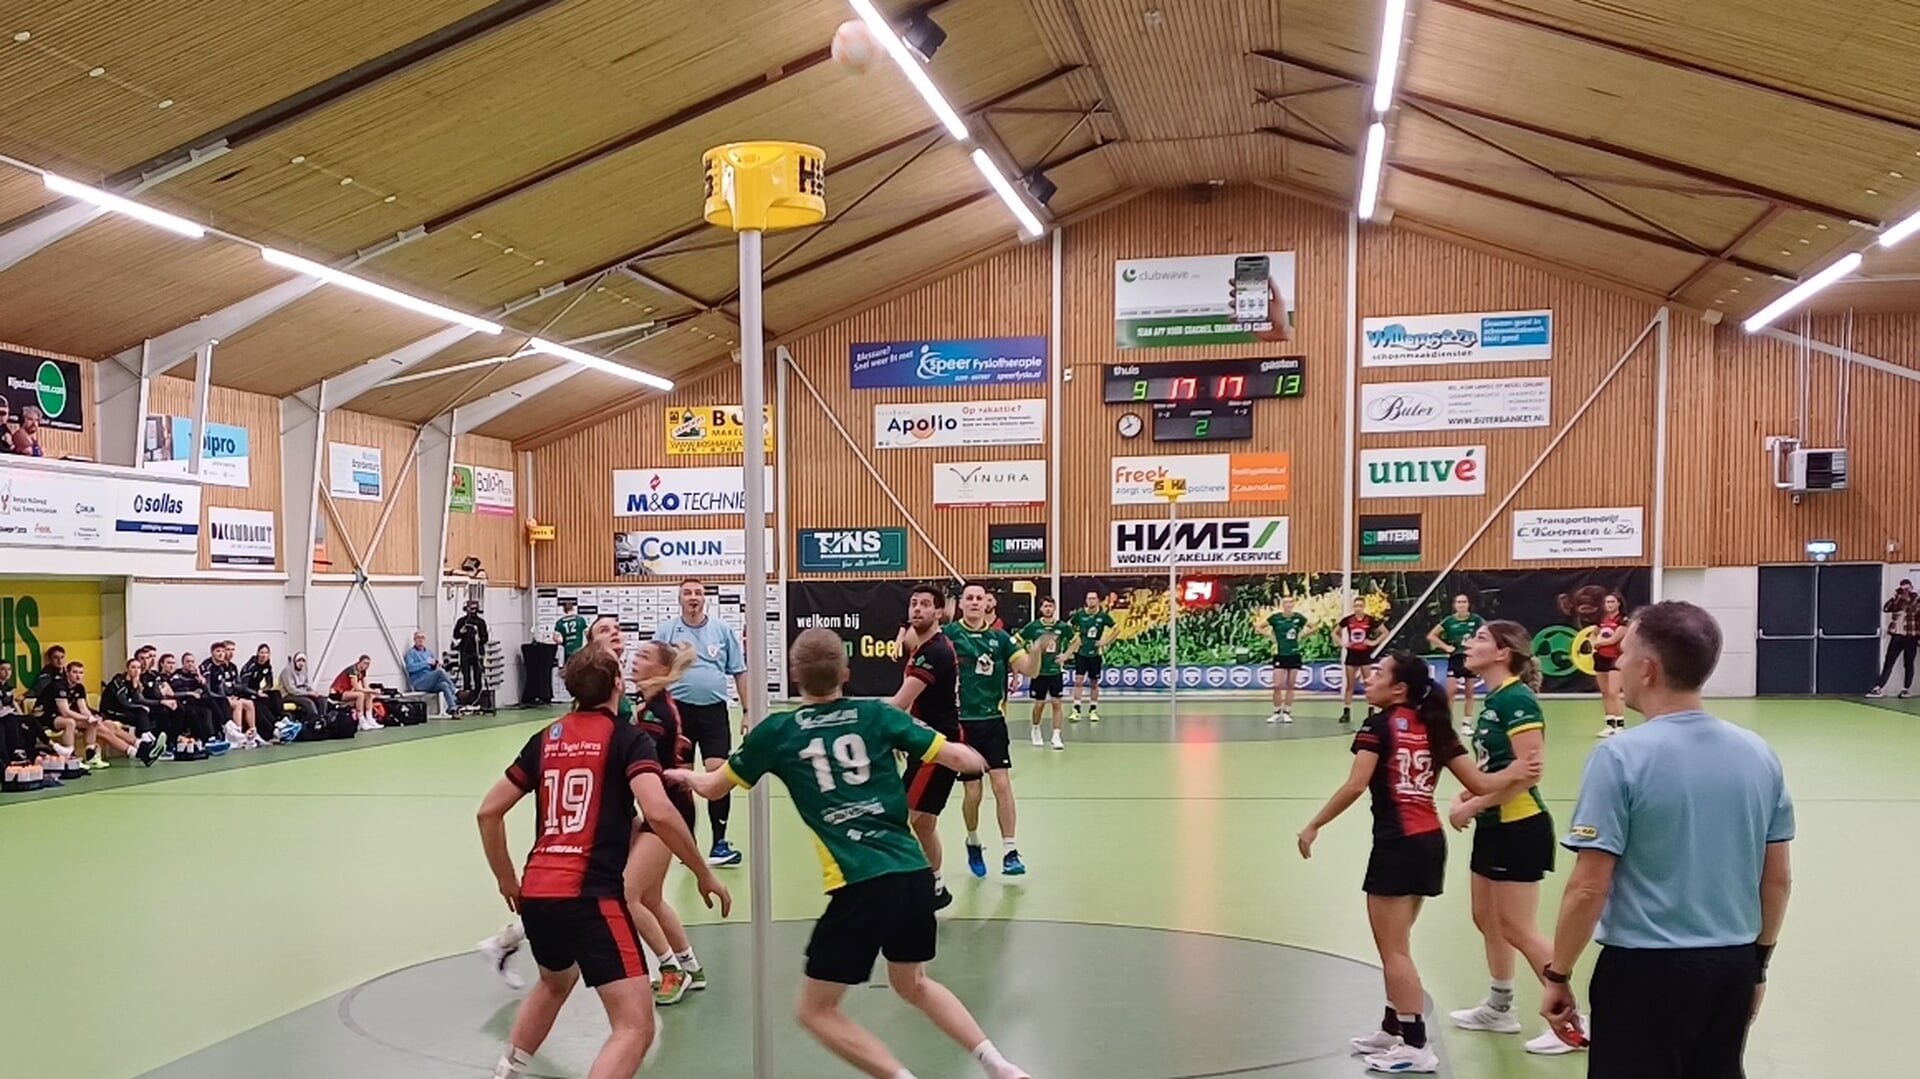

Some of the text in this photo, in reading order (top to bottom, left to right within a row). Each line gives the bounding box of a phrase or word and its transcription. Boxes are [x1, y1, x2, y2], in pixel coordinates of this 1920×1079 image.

[929, 357, 971, 374] speer
[1113, 360, 1299, 376] thuis gasten
[1132, 374, 1301, 400] 9 17 17 13
[962, 404, 1023, 416] Op vakantie?
[1375, 396, 1434, 422] Buter
[1195, 419, 1209, 436] 2
[949, 465, 1030, 483] VINURA
[1115, 465, 1170, 483] Freek
[1368, 449, 1478, 484] univé
[143, 493, 184, 514] sollas
[626, 491, 746, 513] M&O TECHNIE
[640, 536, 722, 561] CONIJN
[1183, 581, 1215, 600] 24
[562, 621, 578, 634] 12
[795, 612, 861, 631] welkom bij
[798, 733, 873, 793] 19
[1395, 747, 1434, 792] 12
[543, 768, 594, 837] 19
